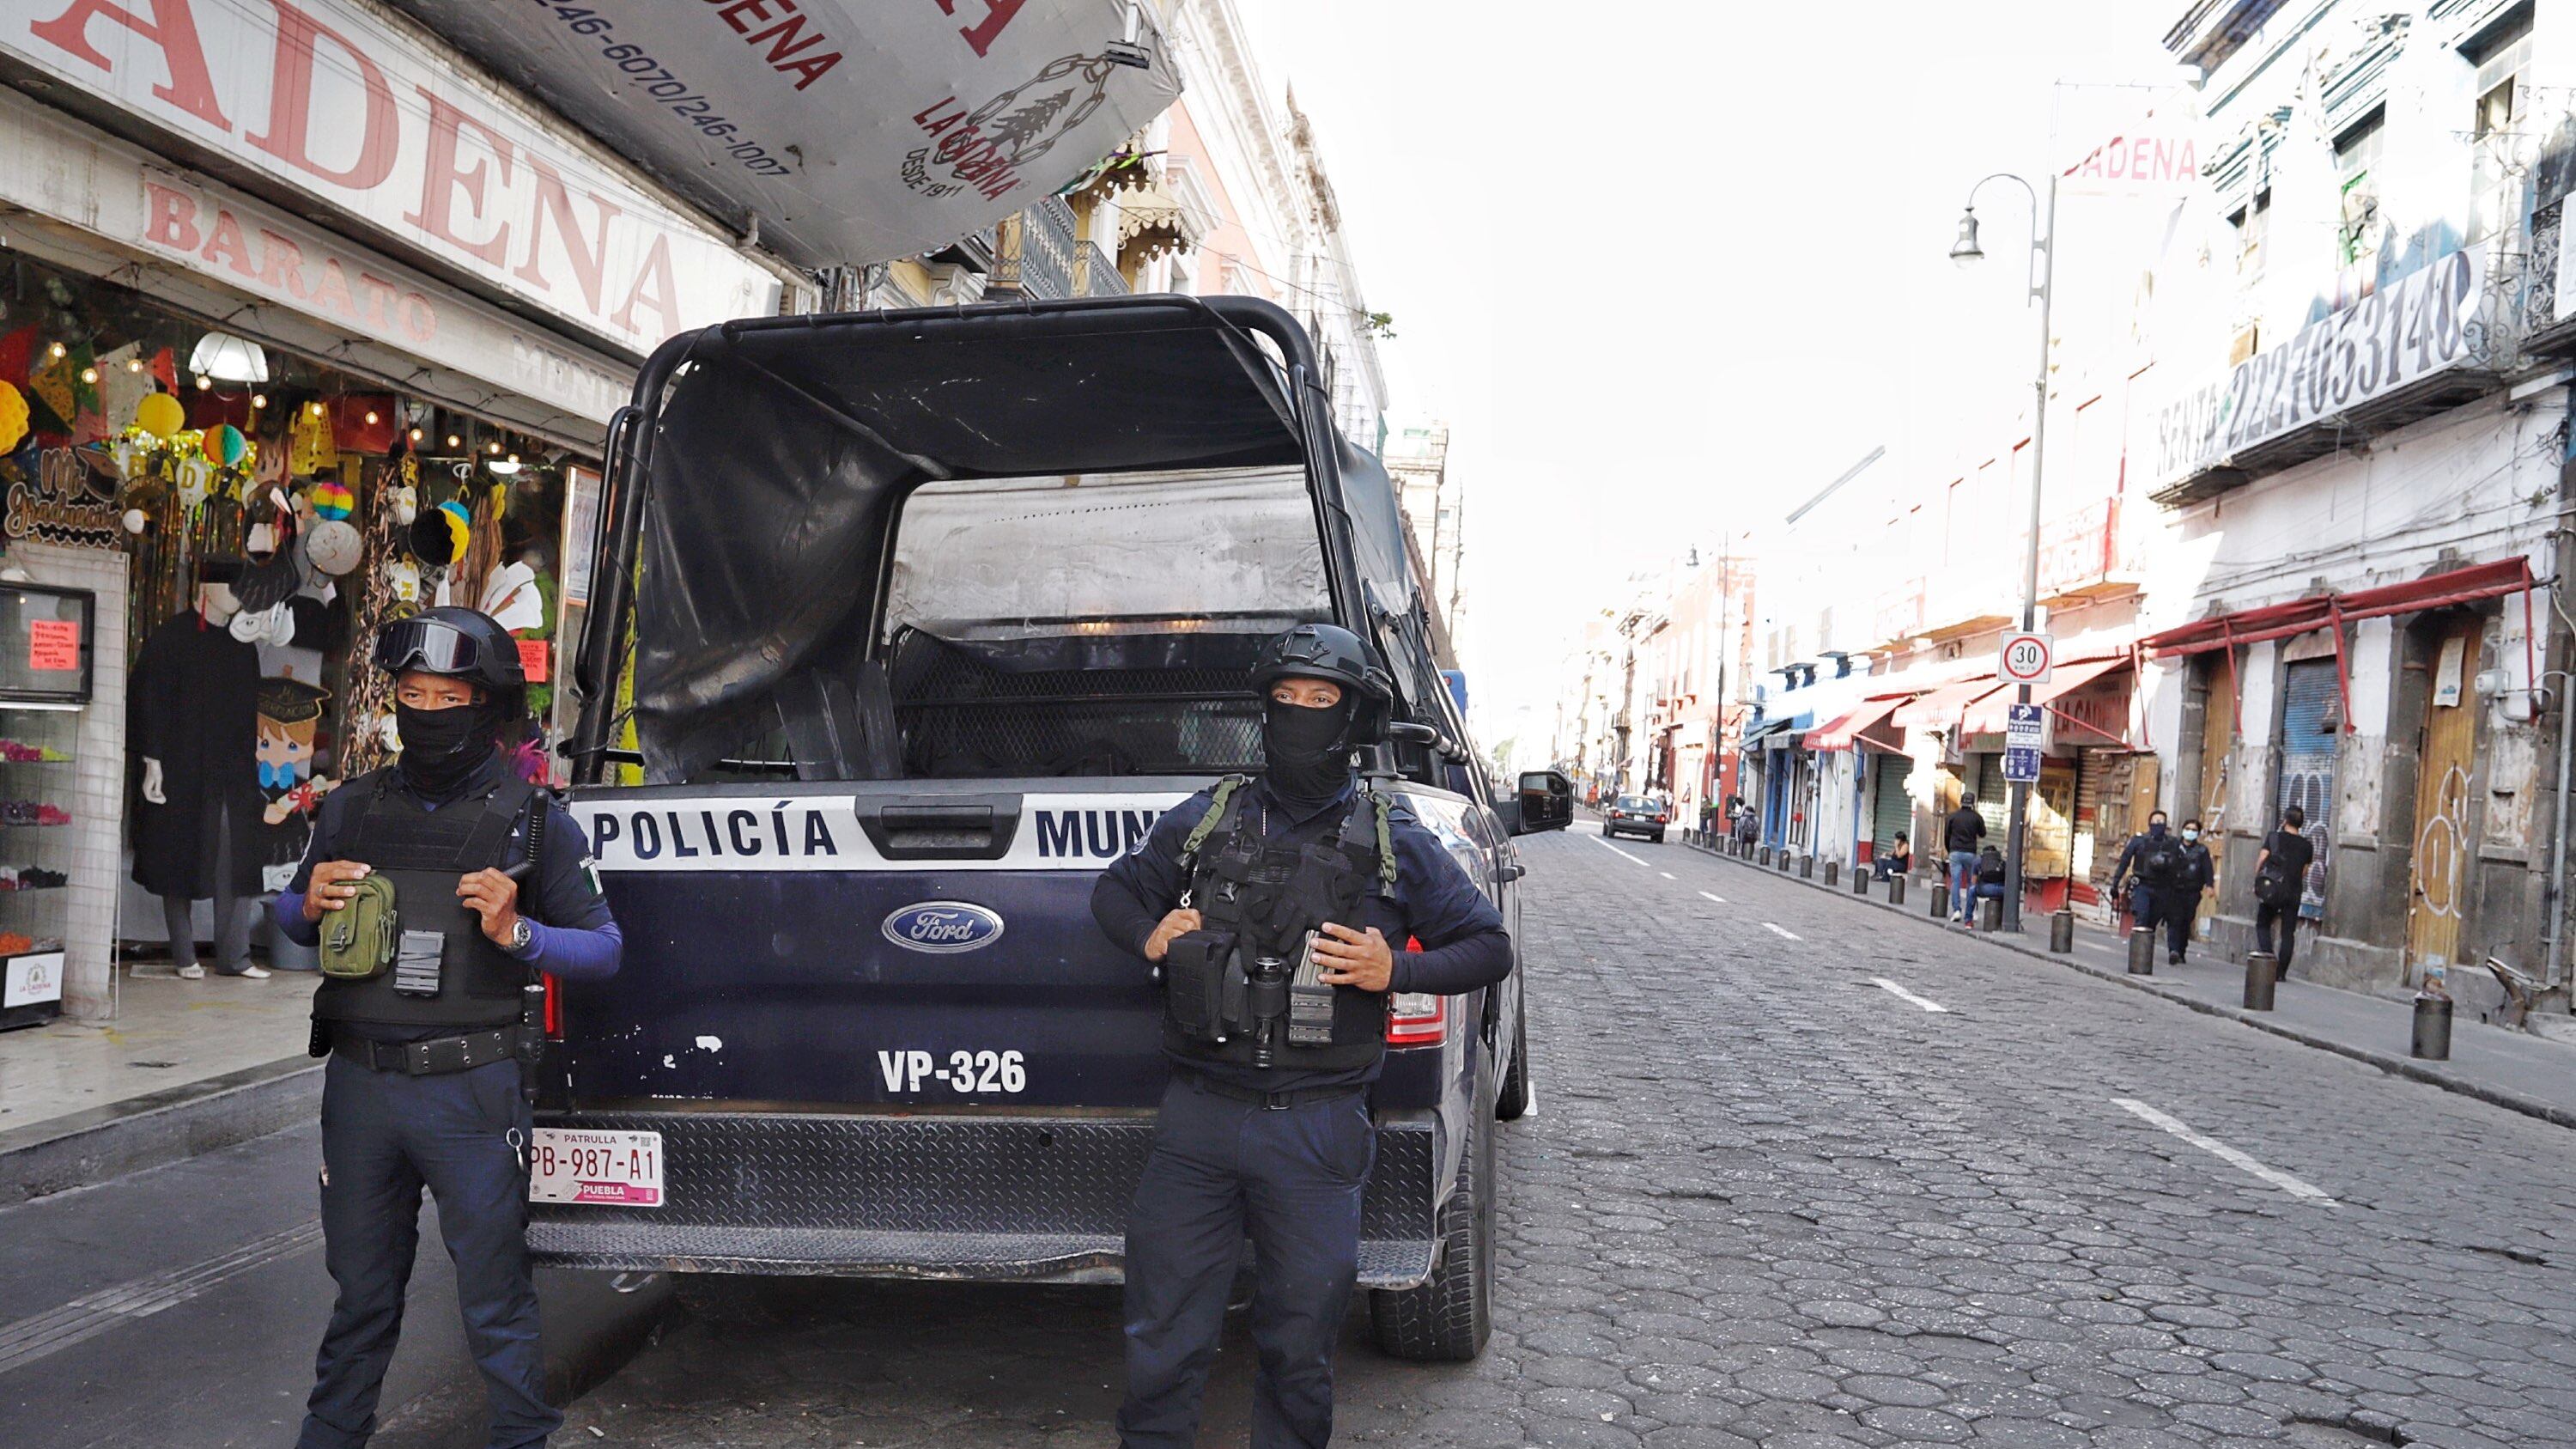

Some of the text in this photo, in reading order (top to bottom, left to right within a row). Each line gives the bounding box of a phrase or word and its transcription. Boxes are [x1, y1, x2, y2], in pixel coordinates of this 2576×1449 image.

[702, 0, 842, 91] ENA
[913, 96, 968, 138] LA
[902, 147, 964, 198] DESDE 1911
[938, 125, 1021, 202] CADENA
[144, 181, 439, 344] BARATO
[2227, 251, 2471, 450] 2227053140
[2015, 646, 2037, 664] 30
[593, 801, 838, 859] POLICÍA
[1036, 811, 1169, 858] MUN
[910, 911, 974, 940] Ford
[878, 1050, 1025, 1093] VP-326
[564, 1134, 617, 1144] PATRULLA
[531, 1146, 653, 1179] PB-987-A1
[583, 1184, 624, 1196] PUEBLA
